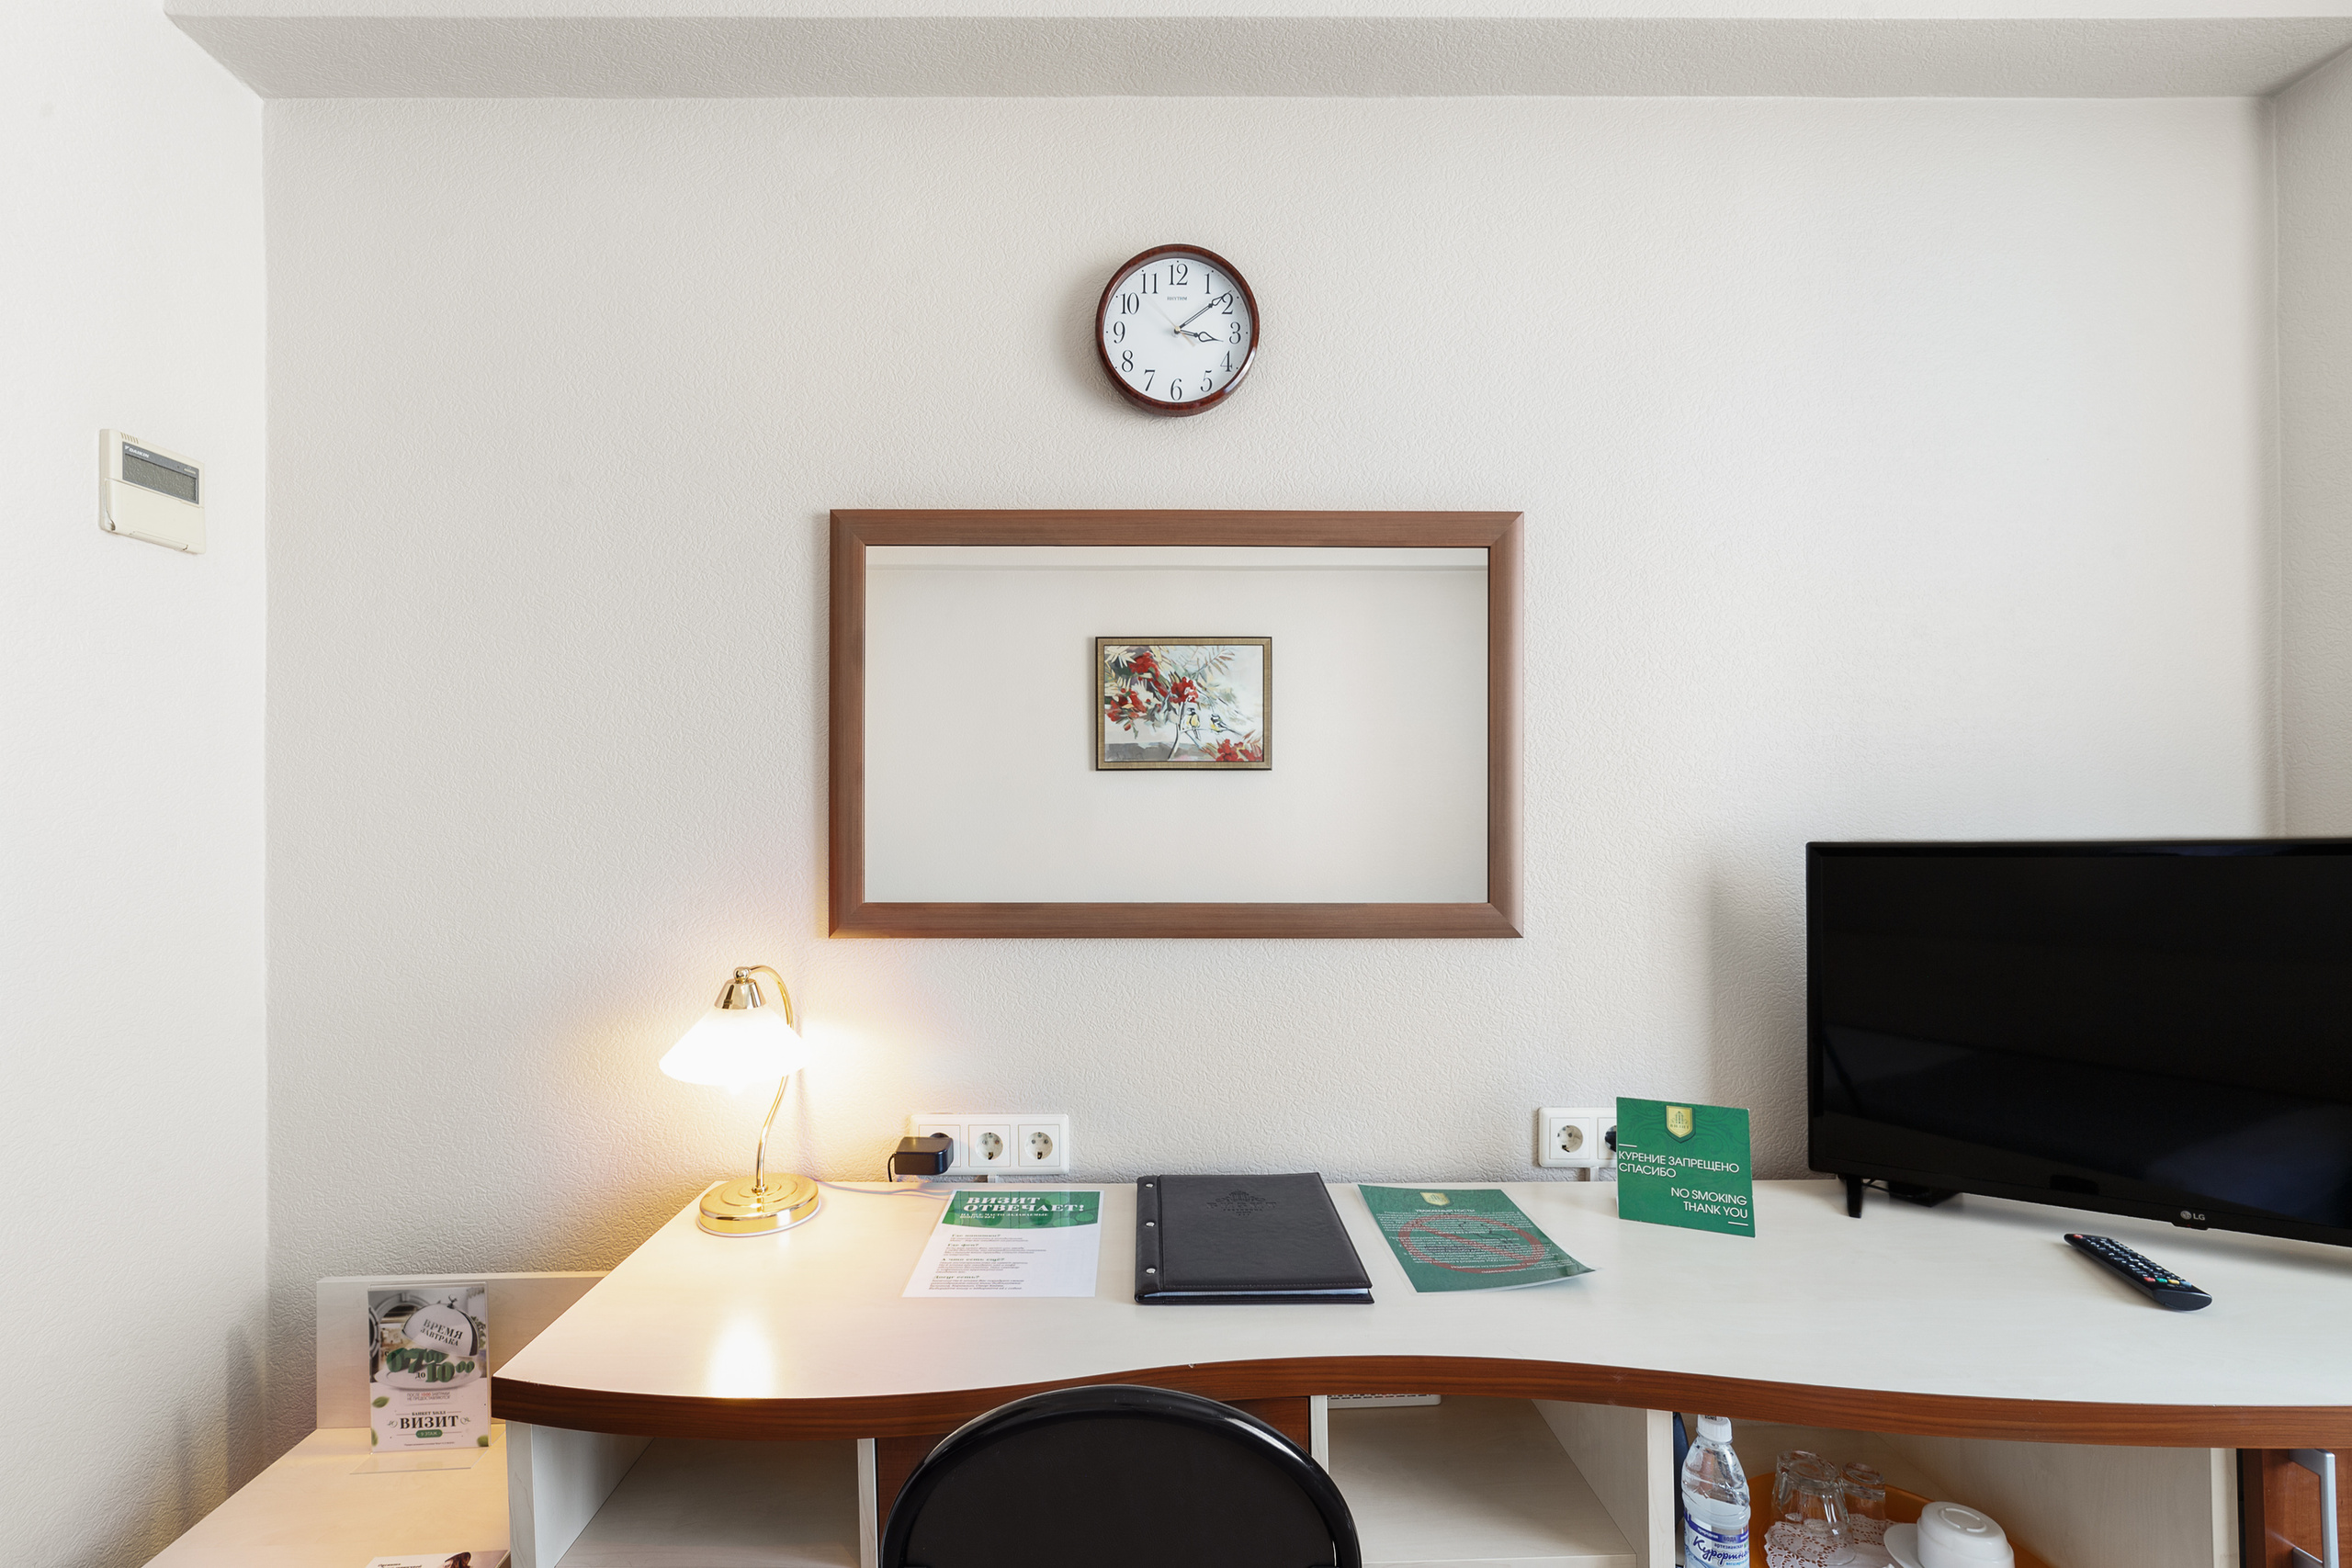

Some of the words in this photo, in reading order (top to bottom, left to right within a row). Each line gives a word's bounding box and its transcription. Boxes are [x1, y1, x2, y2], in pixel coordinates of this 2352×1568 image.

[1141, 273, 1159, 294] 11
[1169, 264, 1188, 286] 12
[1204, 274, 1211, 294] 1
[1121, 292, 1140, 315] 10
[1221, 292, 1234, 315] 2
[1114, 321, 1125, 344] 9
[1229, 321, 1241, 344] 3
[1122, 350, 1134, 372] 8
[1220, 351, 1233, 372] 4
[1145, 369, 1156, 391] 7
[1170, 378, 1182, 401] 6
[1201, 370, 1213, 392] 5
[129, 447, 150, 458] DAIKIN
[1619, 1151, 1666, 1165] КУРЕНИЕ
[1668, 1156, 1740, 1173] ЗАПРЕЩЕНО
[1619, 1163, 1677, 1178] СПАСИБО
[1671, 1187, 1690, 1199] NO
[1691, 1190, 1747, 1206] SMOKING
[1683, 1201, 1721, 1215] THANK
[1723, 1206, 1748, 1219] YOU
[2193, 1213, 2206, 1221] LG
[420, 1328, 459, 1347] ЗАВТРАКА
[424, 1319, 463, 1340] ВРЕМЯ
[400, 1415, 458, 1429] ВИЗИТ
